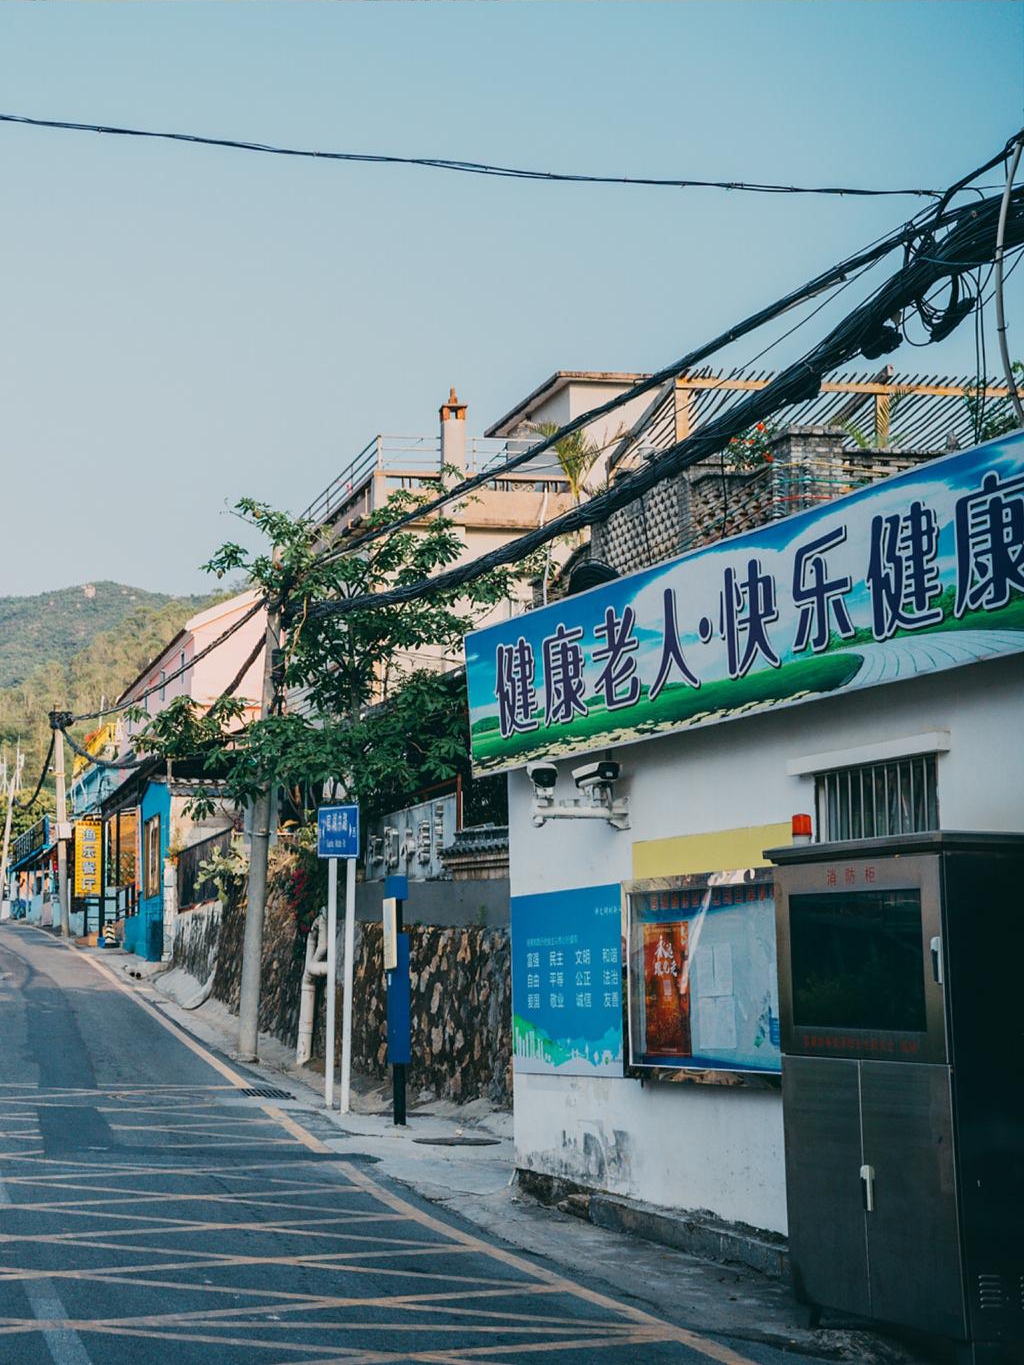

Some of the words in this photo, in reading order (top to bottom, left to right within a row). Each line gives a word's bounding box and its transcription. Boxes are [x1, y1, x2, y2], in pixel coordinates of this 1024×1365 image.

[826, 866, 876, 886] 消防柜
[549, 951, 564, 966] 民主
[575, 949, 591, 965] 文明
[602, 947, 618, 964] 和谐
[549, 971, 564, 988] 平等
[575, 970, 591, 986] 公正
[602, 969, 618, 985] 法治
[576, 992, 592, 1007] 诚信
[603, 991, 619, 1007] 友善
